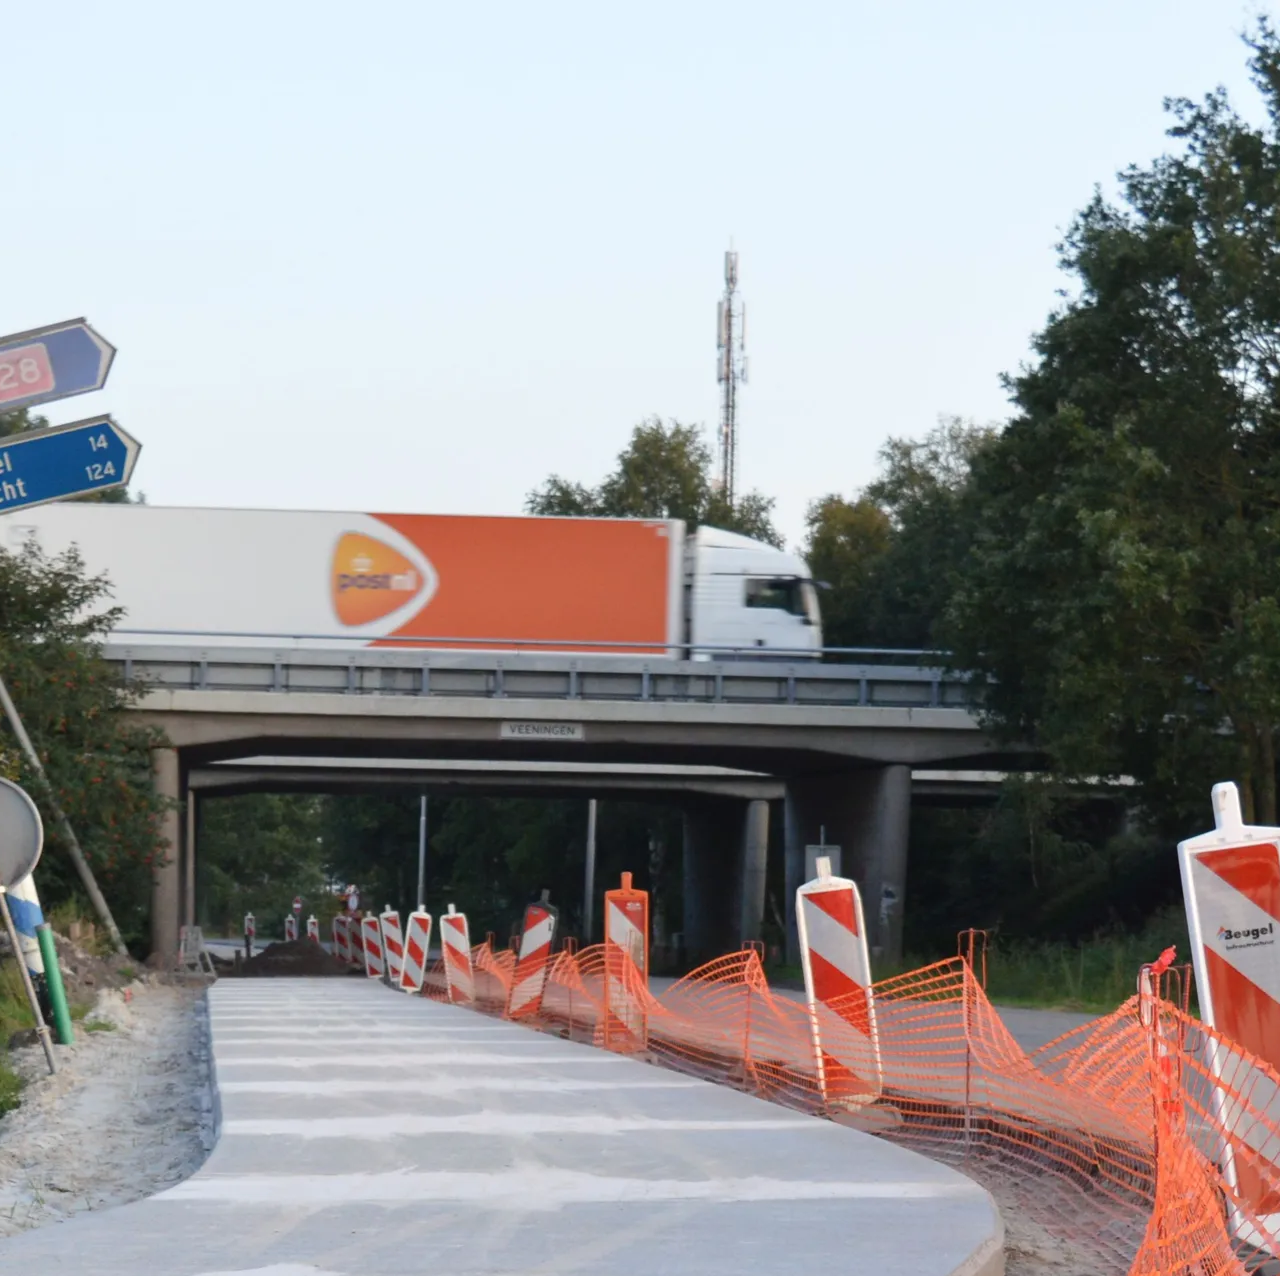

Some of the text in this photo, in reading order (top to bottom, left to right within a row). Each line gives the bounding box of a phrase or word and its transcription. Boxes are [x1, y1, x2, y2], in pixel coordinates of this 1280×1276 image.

[88, 434, 108, 452] 14
[85, 461, 116, 481] 124
[509, 723, 576, 736] VEENINGEN
[1224, 922, 1273, 940] Beugel
